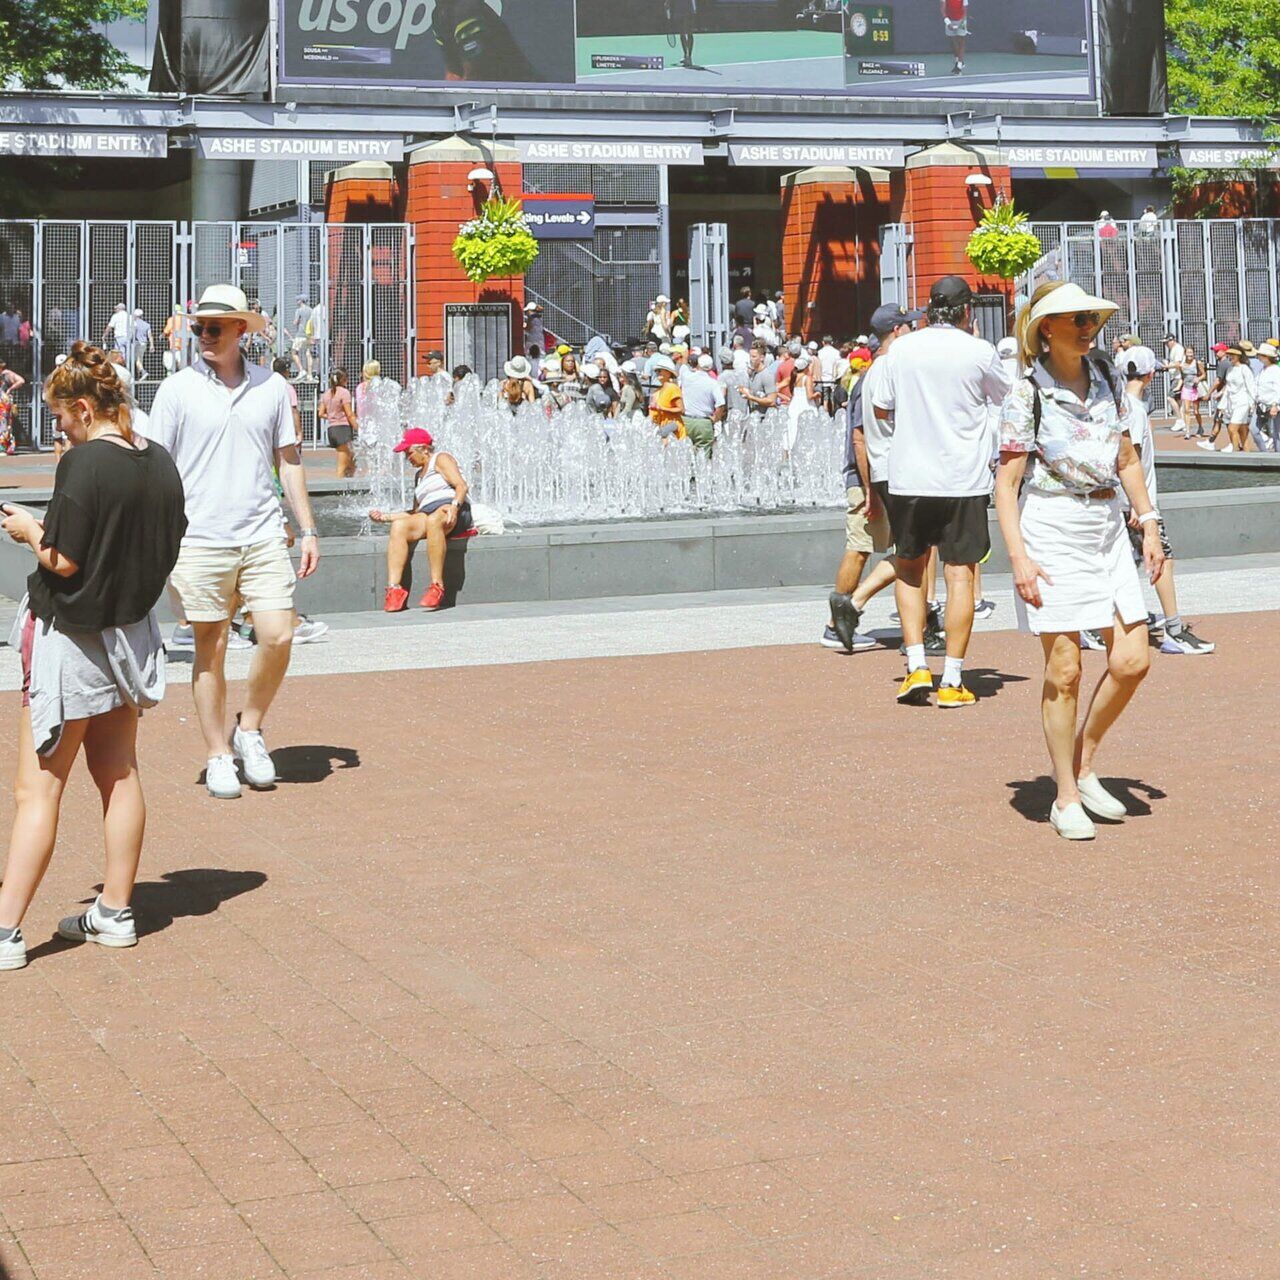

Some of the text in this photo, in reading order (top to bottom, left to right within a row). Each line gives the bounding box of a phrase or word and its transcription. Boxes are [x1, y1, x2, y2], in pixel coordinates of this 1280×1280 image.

[14, 133, 92, 150] STADIUM
[97, 135, 155, 151] ENTRY
[210, 138, 392, 155] ASHE STADIUM ENTRY
[527, 144, 692, 158] ASHE STADIUM ENTRY
[740, 147, 894, 161] ASHE STADIUM ENTRY
[1008, 148, 1147, 162] ASHE STADIUM ENTRY
[1189, 150, 1220, 162] ASHE
[545, 213, 575, 223] Levels
